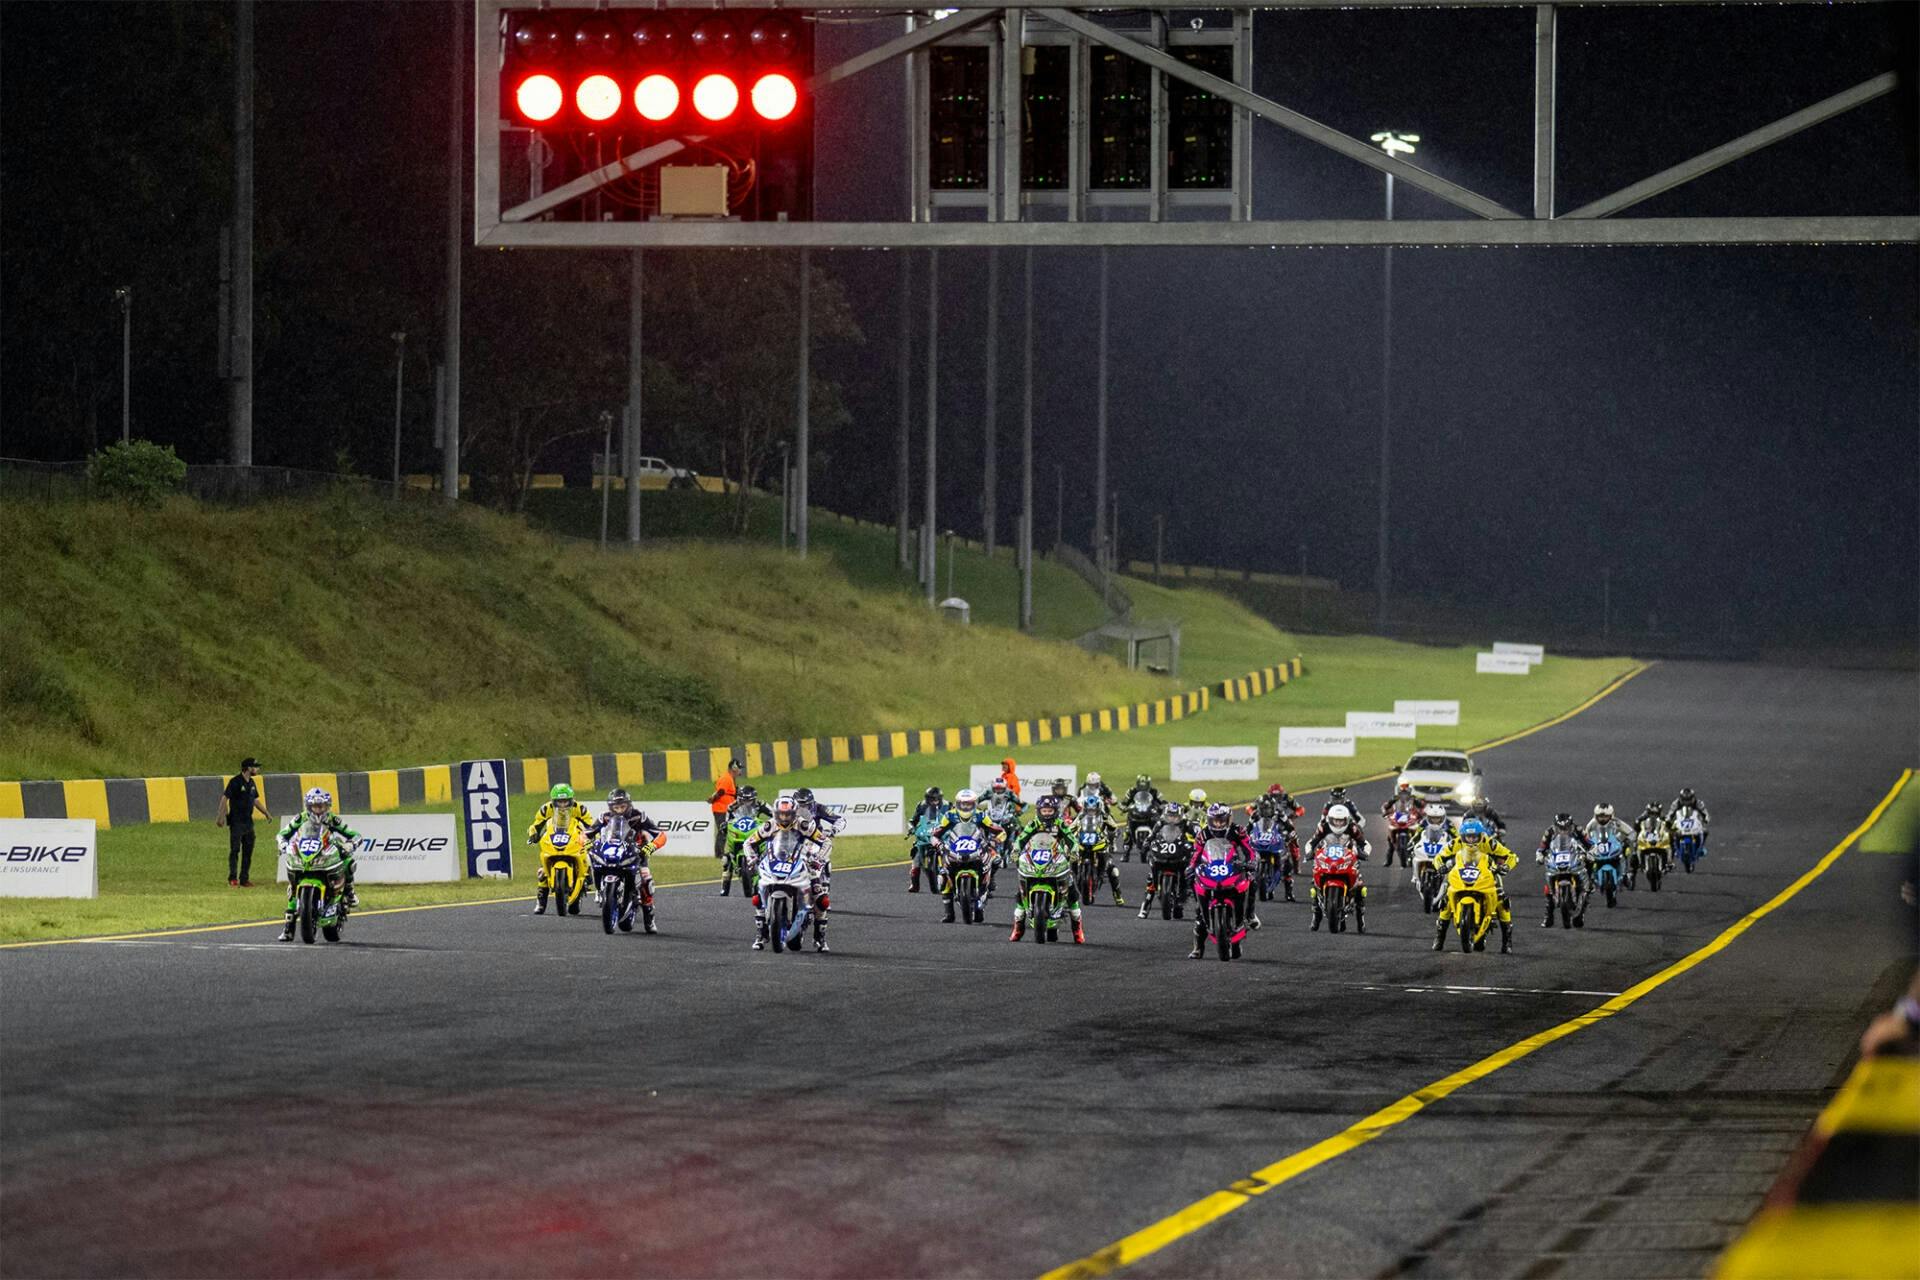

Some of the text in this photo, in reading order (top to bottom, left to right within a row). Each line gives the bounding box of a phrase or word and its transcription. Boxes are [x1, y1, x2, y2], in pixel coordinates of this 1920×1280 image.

[467, 762, 508, 880] ARDC
[658, 820, 710, 832] BIKE
[553, 834, 570, 844] 66
[1083, 833, 1097, 844] 23
[955, 839, 978, 851] 128
[1160, 843, 1177, 854] 20
[0, 846, 88, 862] -BIKE
[1209, 865, 1230, 877] 39
[1461, 869, 1480, 879] 33
